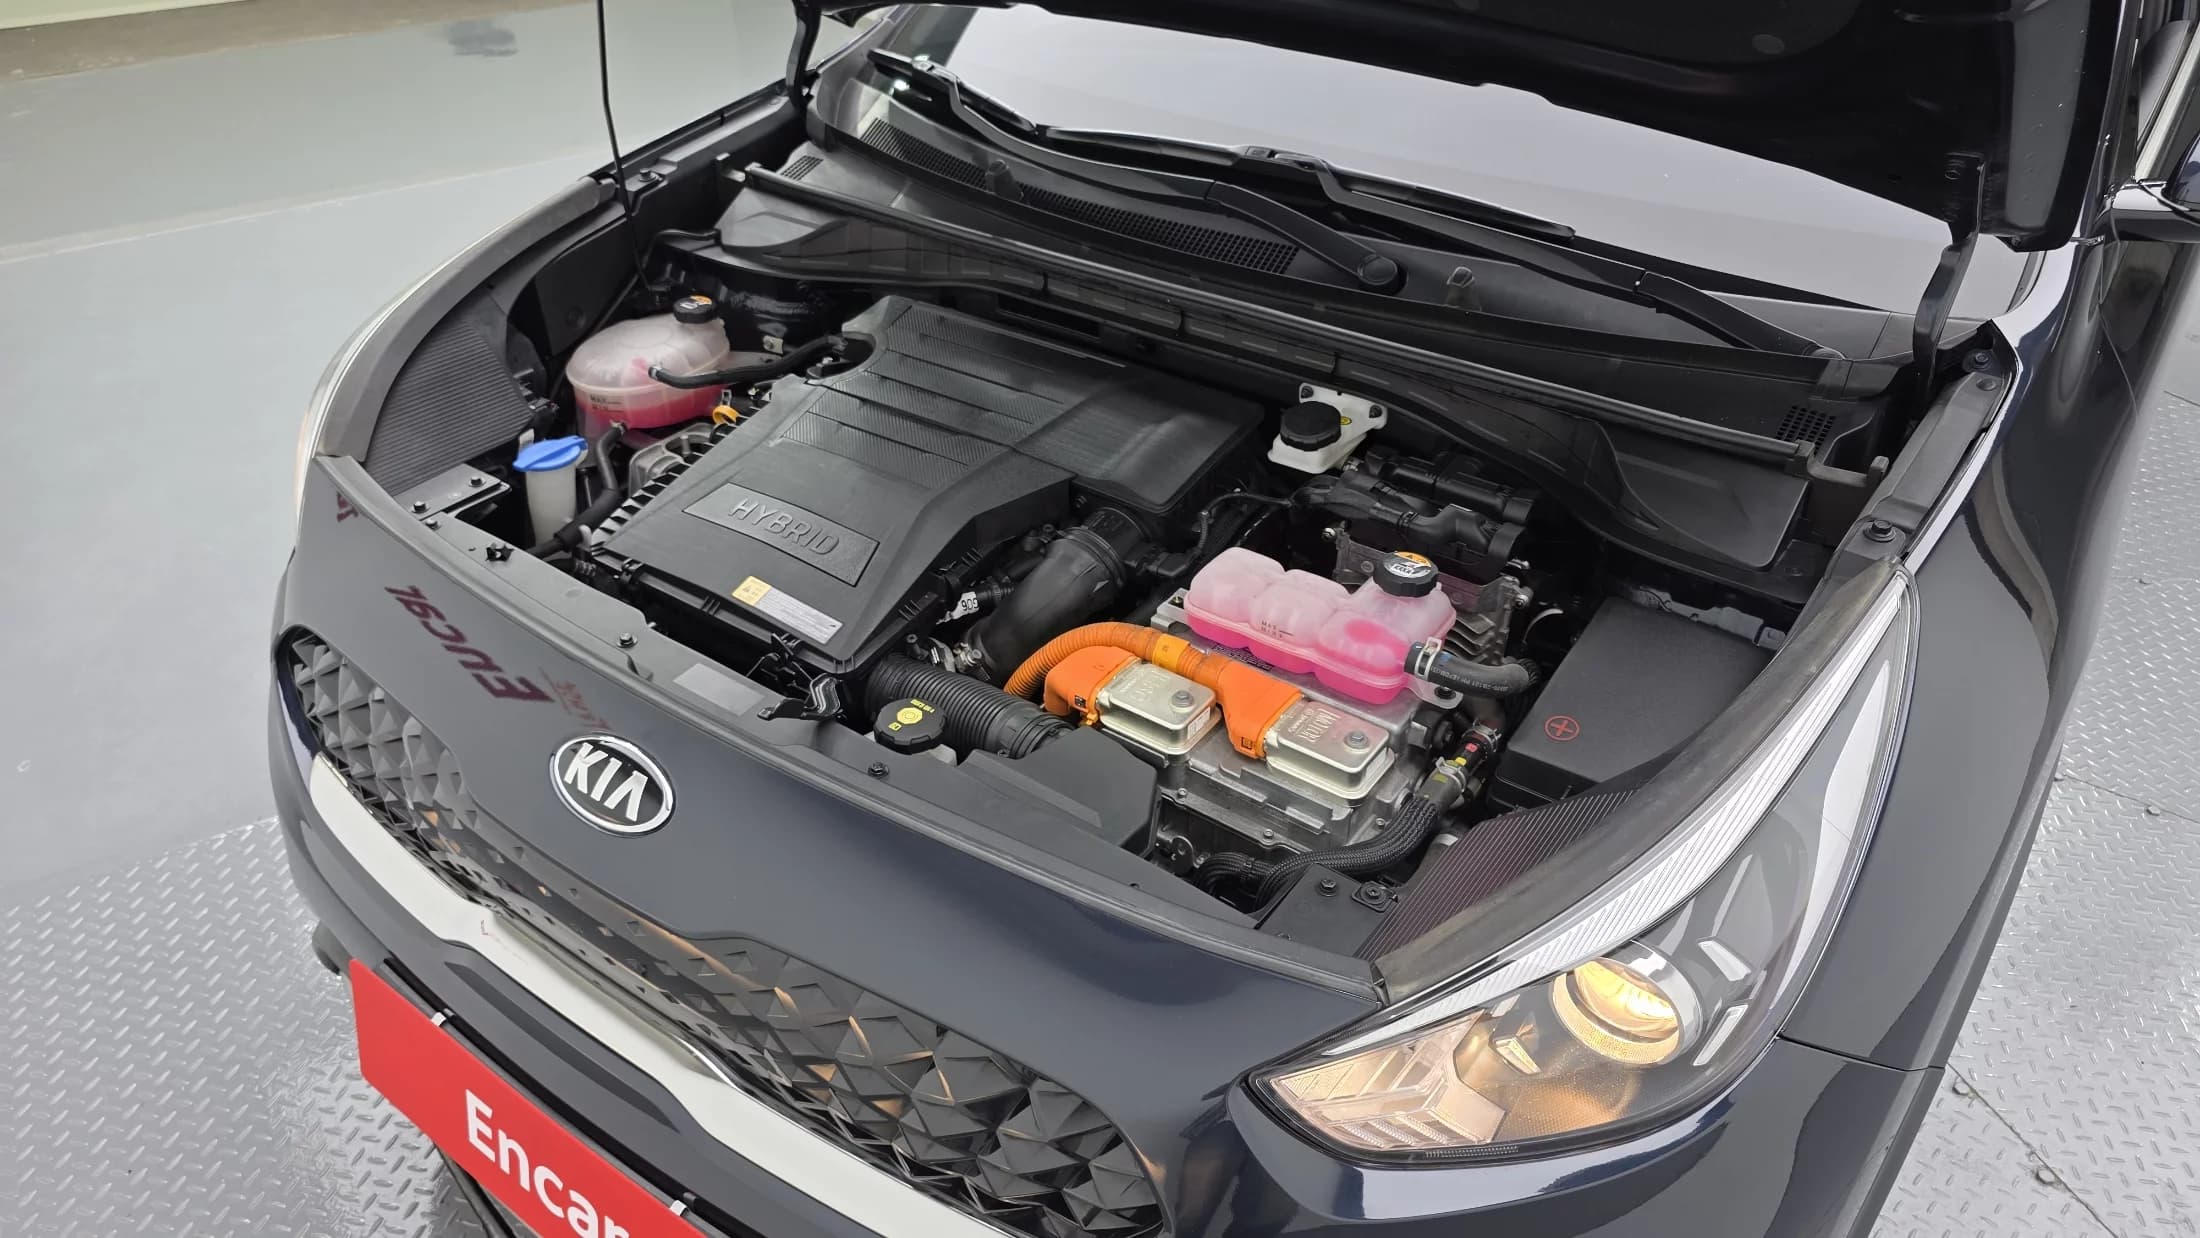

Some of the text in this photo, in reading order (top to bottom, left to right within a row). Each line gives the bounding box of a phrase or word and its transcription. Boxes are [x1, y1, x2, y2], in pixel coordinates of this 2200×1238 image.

[728, 498, 840, 555] HYBRID
[563, 741, 649, 822] KIA
[465, 1088, 630, 1238] Encar
